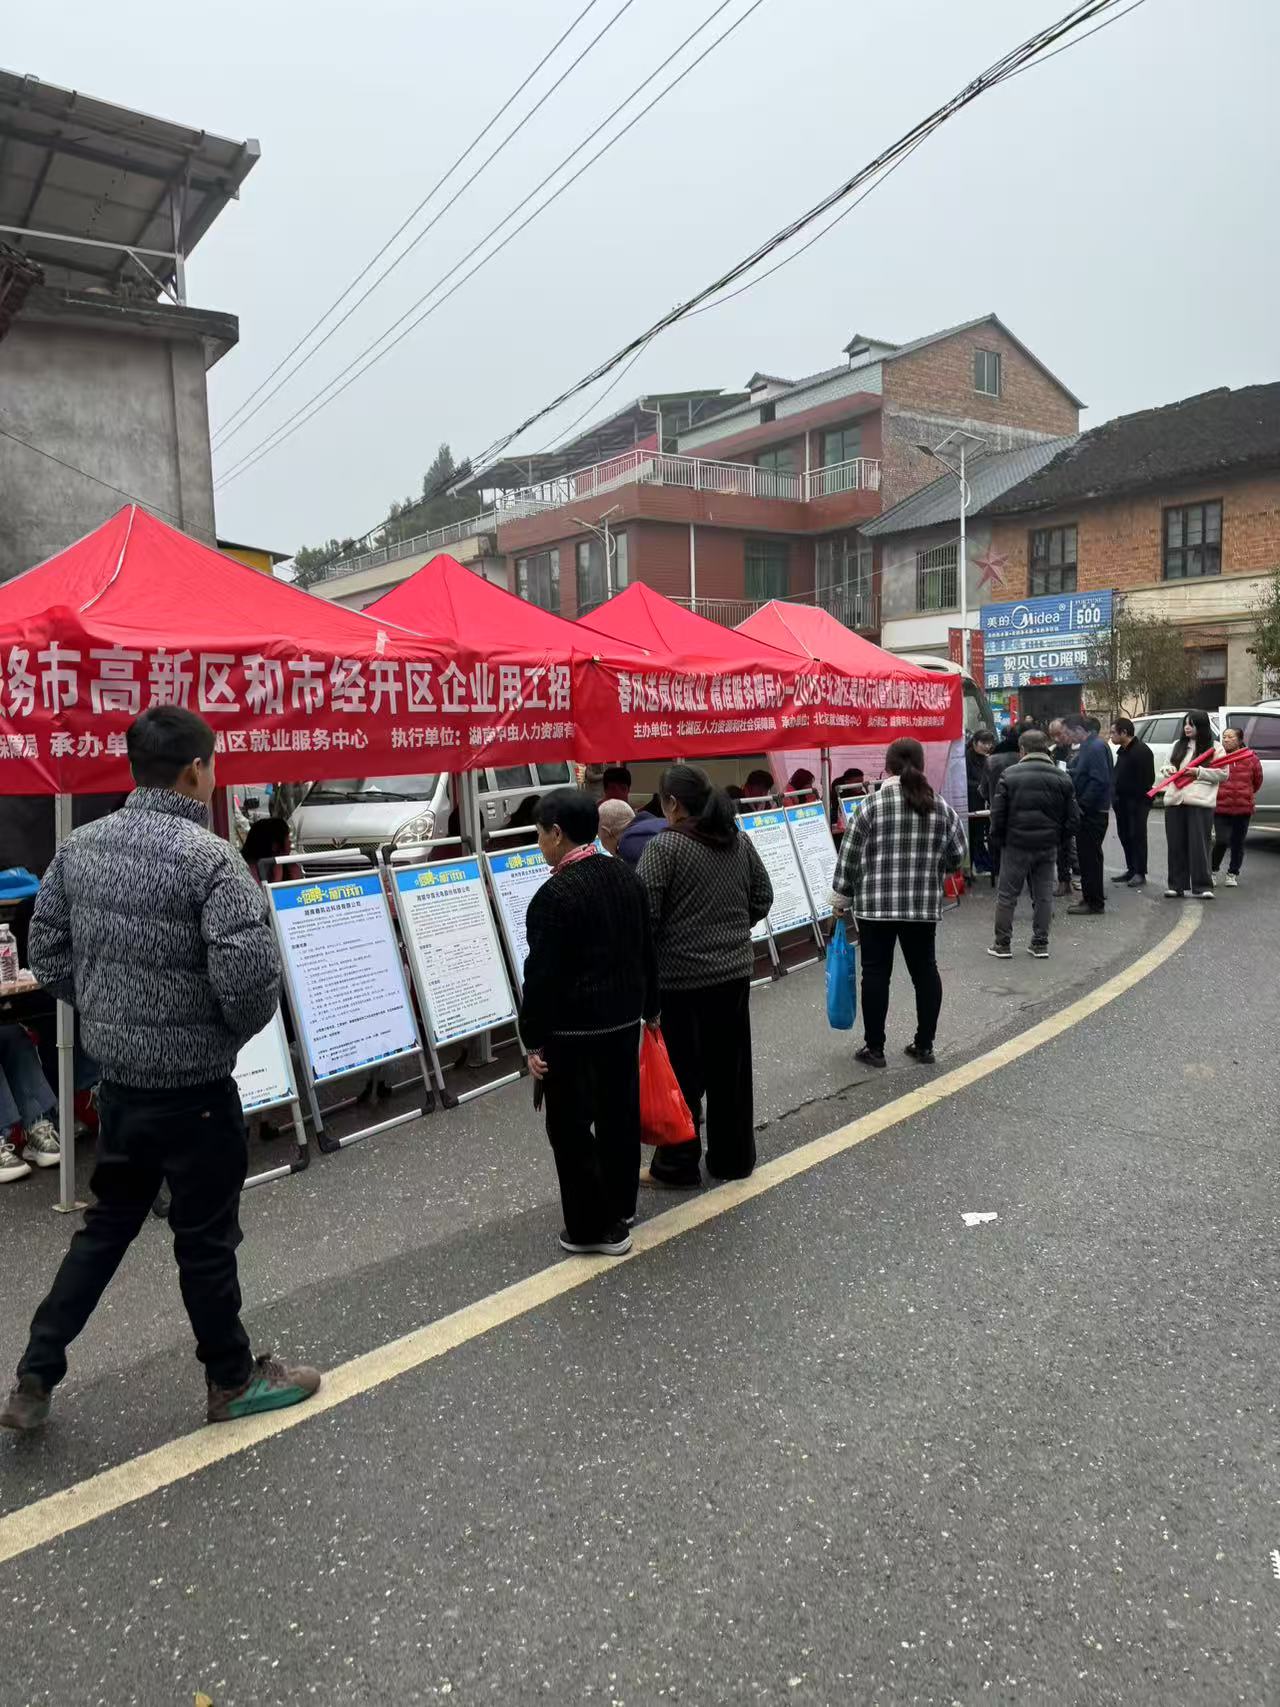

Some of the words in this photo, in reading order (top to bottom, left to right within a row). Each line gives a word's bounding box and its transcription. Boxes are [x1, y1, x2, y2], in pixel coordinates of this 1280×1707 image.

[987, 616, 1010, 628] 美的
[1014, 607, 1060, 627] Midea
[1077, 608, 1100, 624] 500
[1004, 650, 1087, 671] 视贝LED照明
[0, 641, 571, 718] 务市高新区和市经开区企业用工招
[617, 672, 708, 713] 春风送岗促就业
